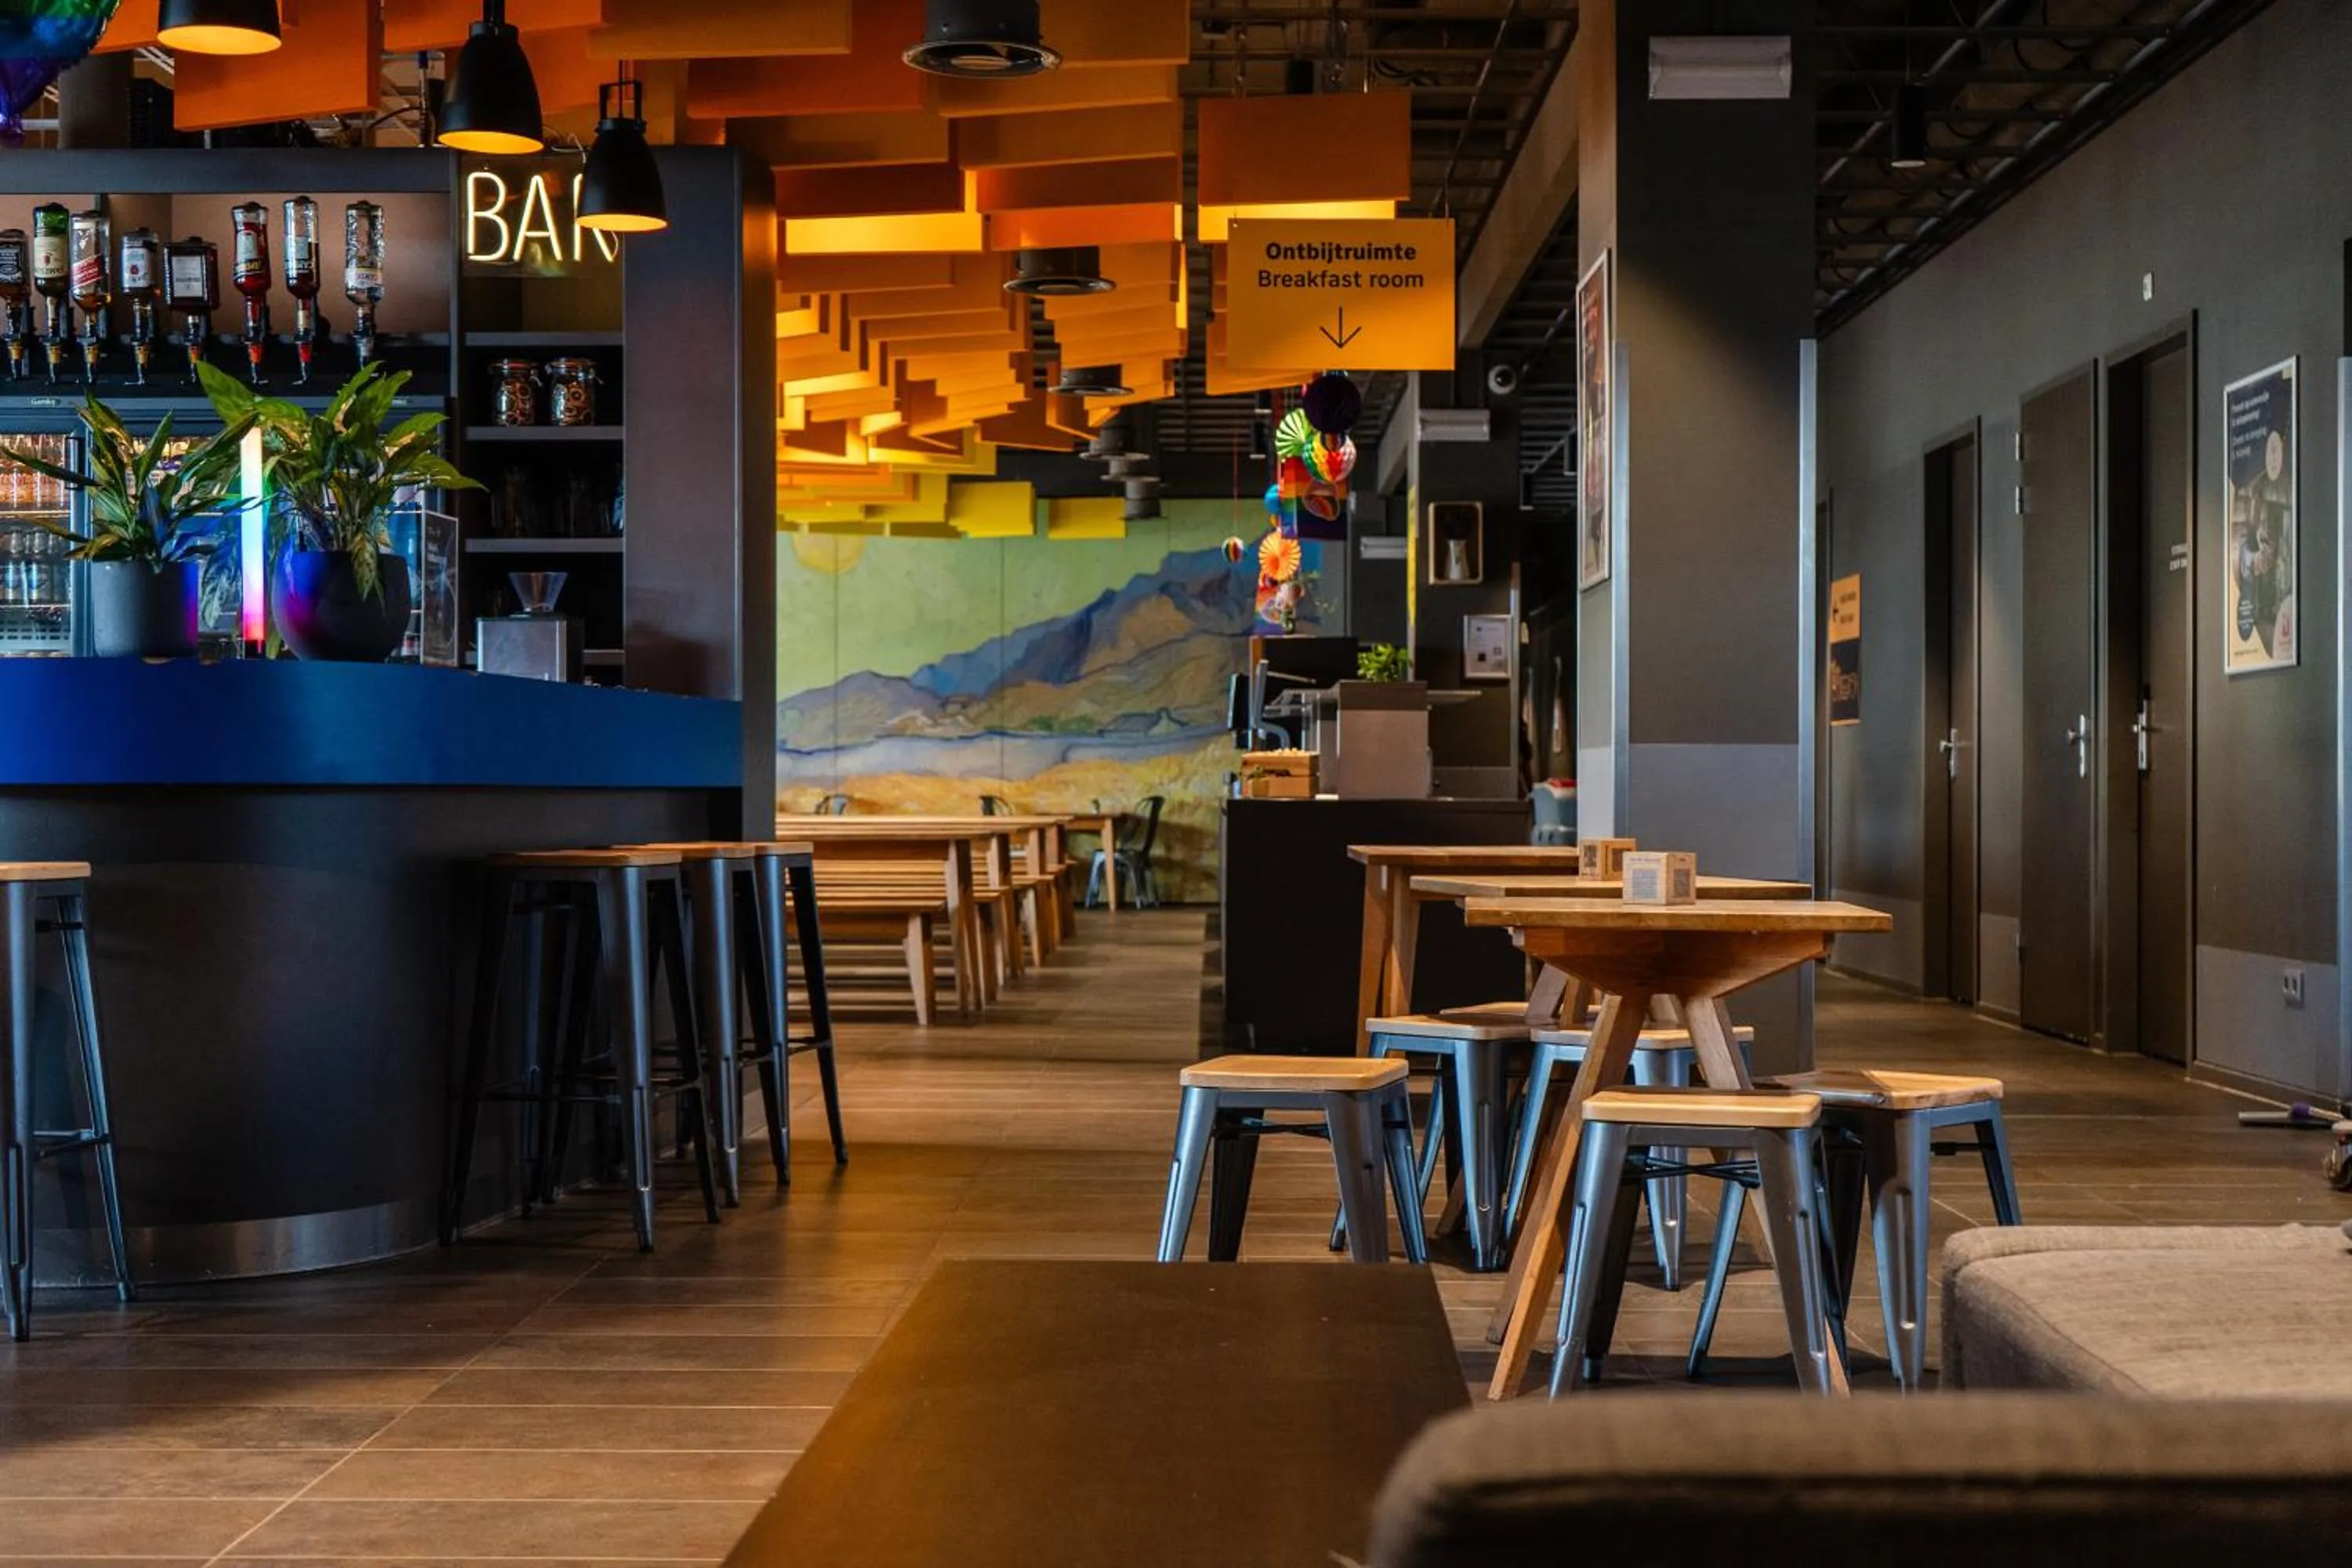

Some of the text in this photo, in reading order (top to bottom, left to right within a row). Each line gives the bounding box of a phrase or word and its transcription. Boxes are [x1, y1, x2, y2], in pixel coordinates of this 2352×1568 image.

[1266, 241, 1417, 264] Ontbijtruimte
[1258, 270, 1425, 288] Breakfast room
